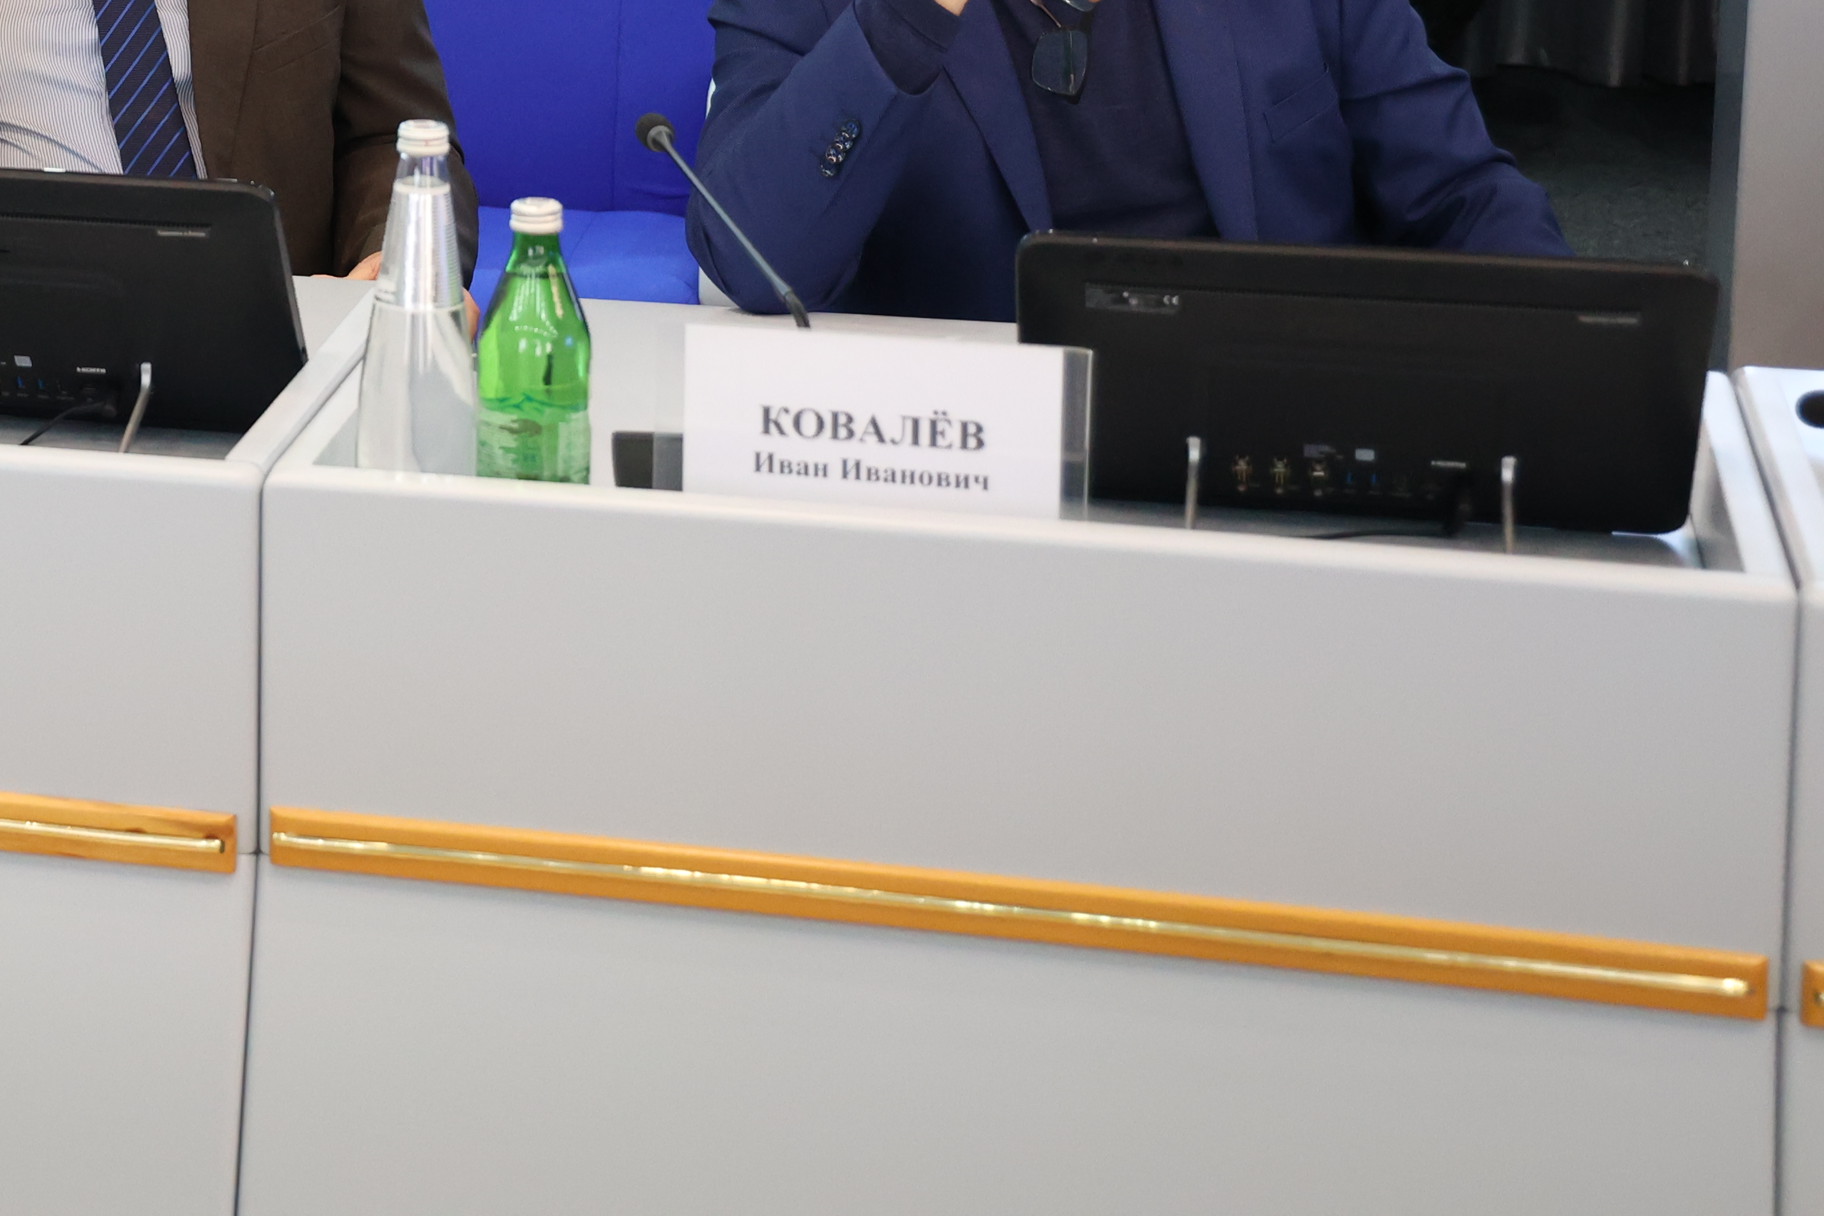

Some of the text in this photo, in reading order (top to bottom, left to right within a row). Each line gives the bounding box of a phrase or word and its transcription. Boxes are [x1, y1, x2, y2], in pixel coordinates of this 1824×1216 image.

[760, 404, 987, 452] КОВАЛЁВ
[753, 451, 990, 492] Иван Иванович
